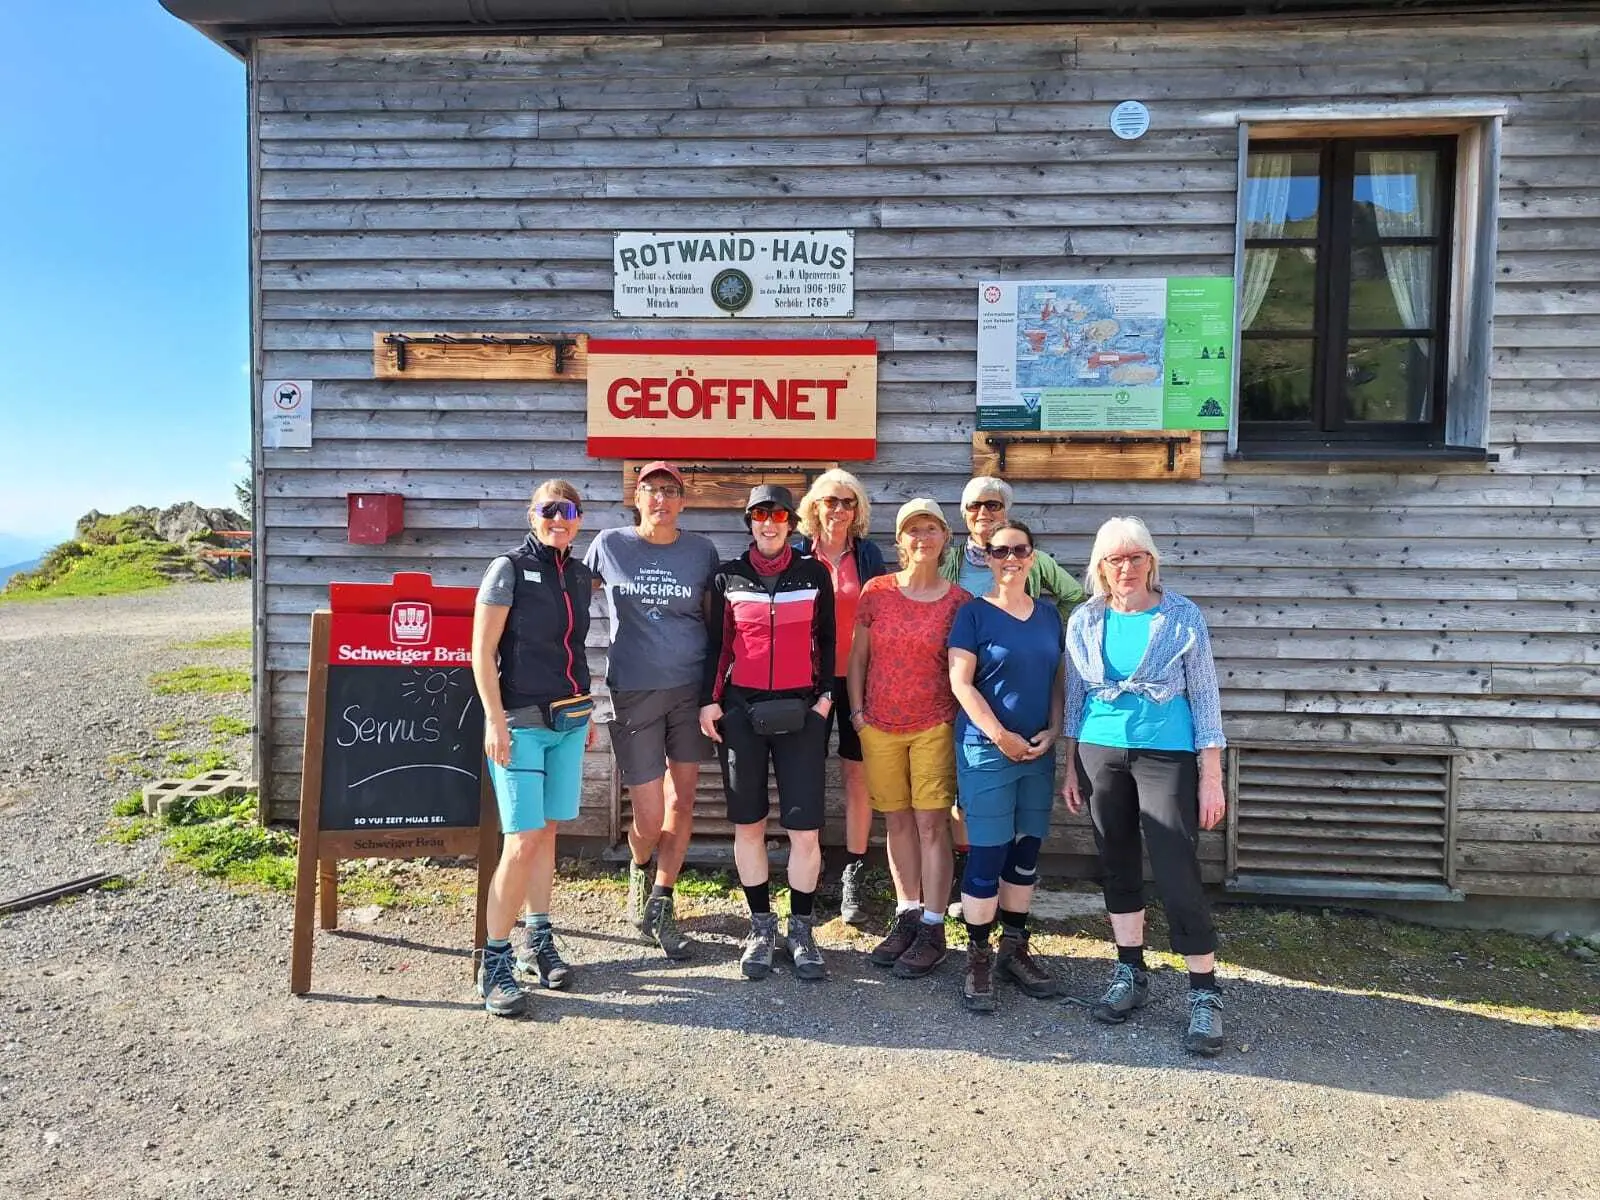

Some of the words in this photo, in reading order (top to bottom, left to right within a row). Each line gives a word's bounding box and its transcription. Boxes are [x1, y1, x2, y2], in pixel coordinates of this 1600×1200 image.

[619, 238, 848, 272] ROTWAND-HAUS
[777, 283, 801, 294] Jahren
[607, 369, 848, 421] GEÖFFNET
[619, 583, 692, 598] EINKEHREN
[338, 645, 431, 665] Schweiger
[385, 817, 403, 825] ZEIT
[353, 839, 414, 852] Schweiger
[415, 837, 444, 848] Bräu
